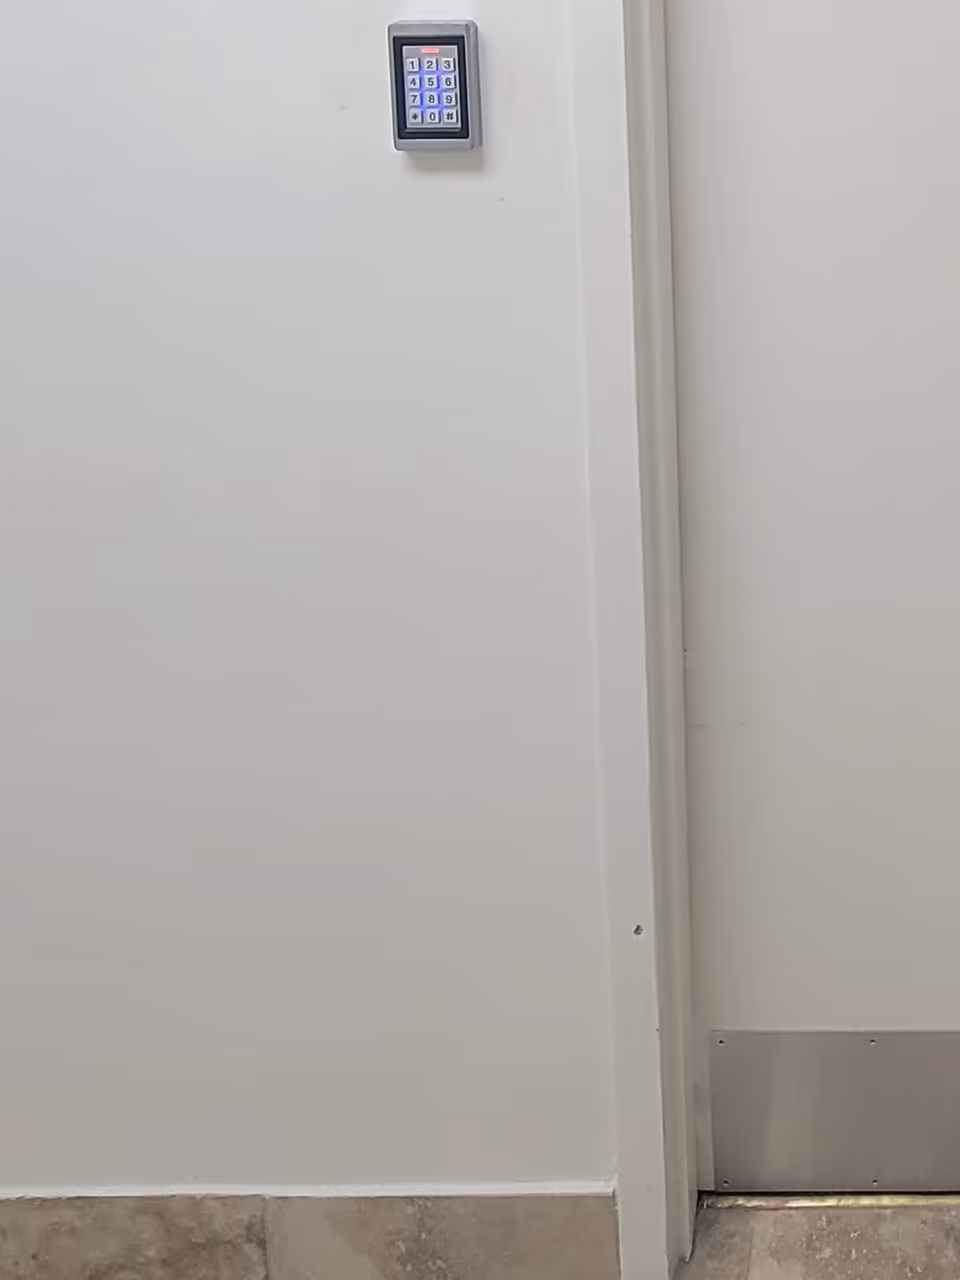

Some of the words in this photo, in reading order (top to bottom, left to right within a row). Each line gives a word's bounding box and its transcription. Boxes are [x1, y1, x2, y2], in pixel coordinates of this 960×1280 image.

[410, 61, 415, 69] 1
[427, 61, 433, 69] 2
[444, 60, 451, 69] 3
[410, 77, 416, 86] 4
[427, 77, 434, 86] 5
[445, 77, 452, 86] 6
[411, 95, 417, 103] 7
[428, 95, 435, 103] 8
[446, 95, 453, 104] 9
[430, 112, 436, 121] 0
